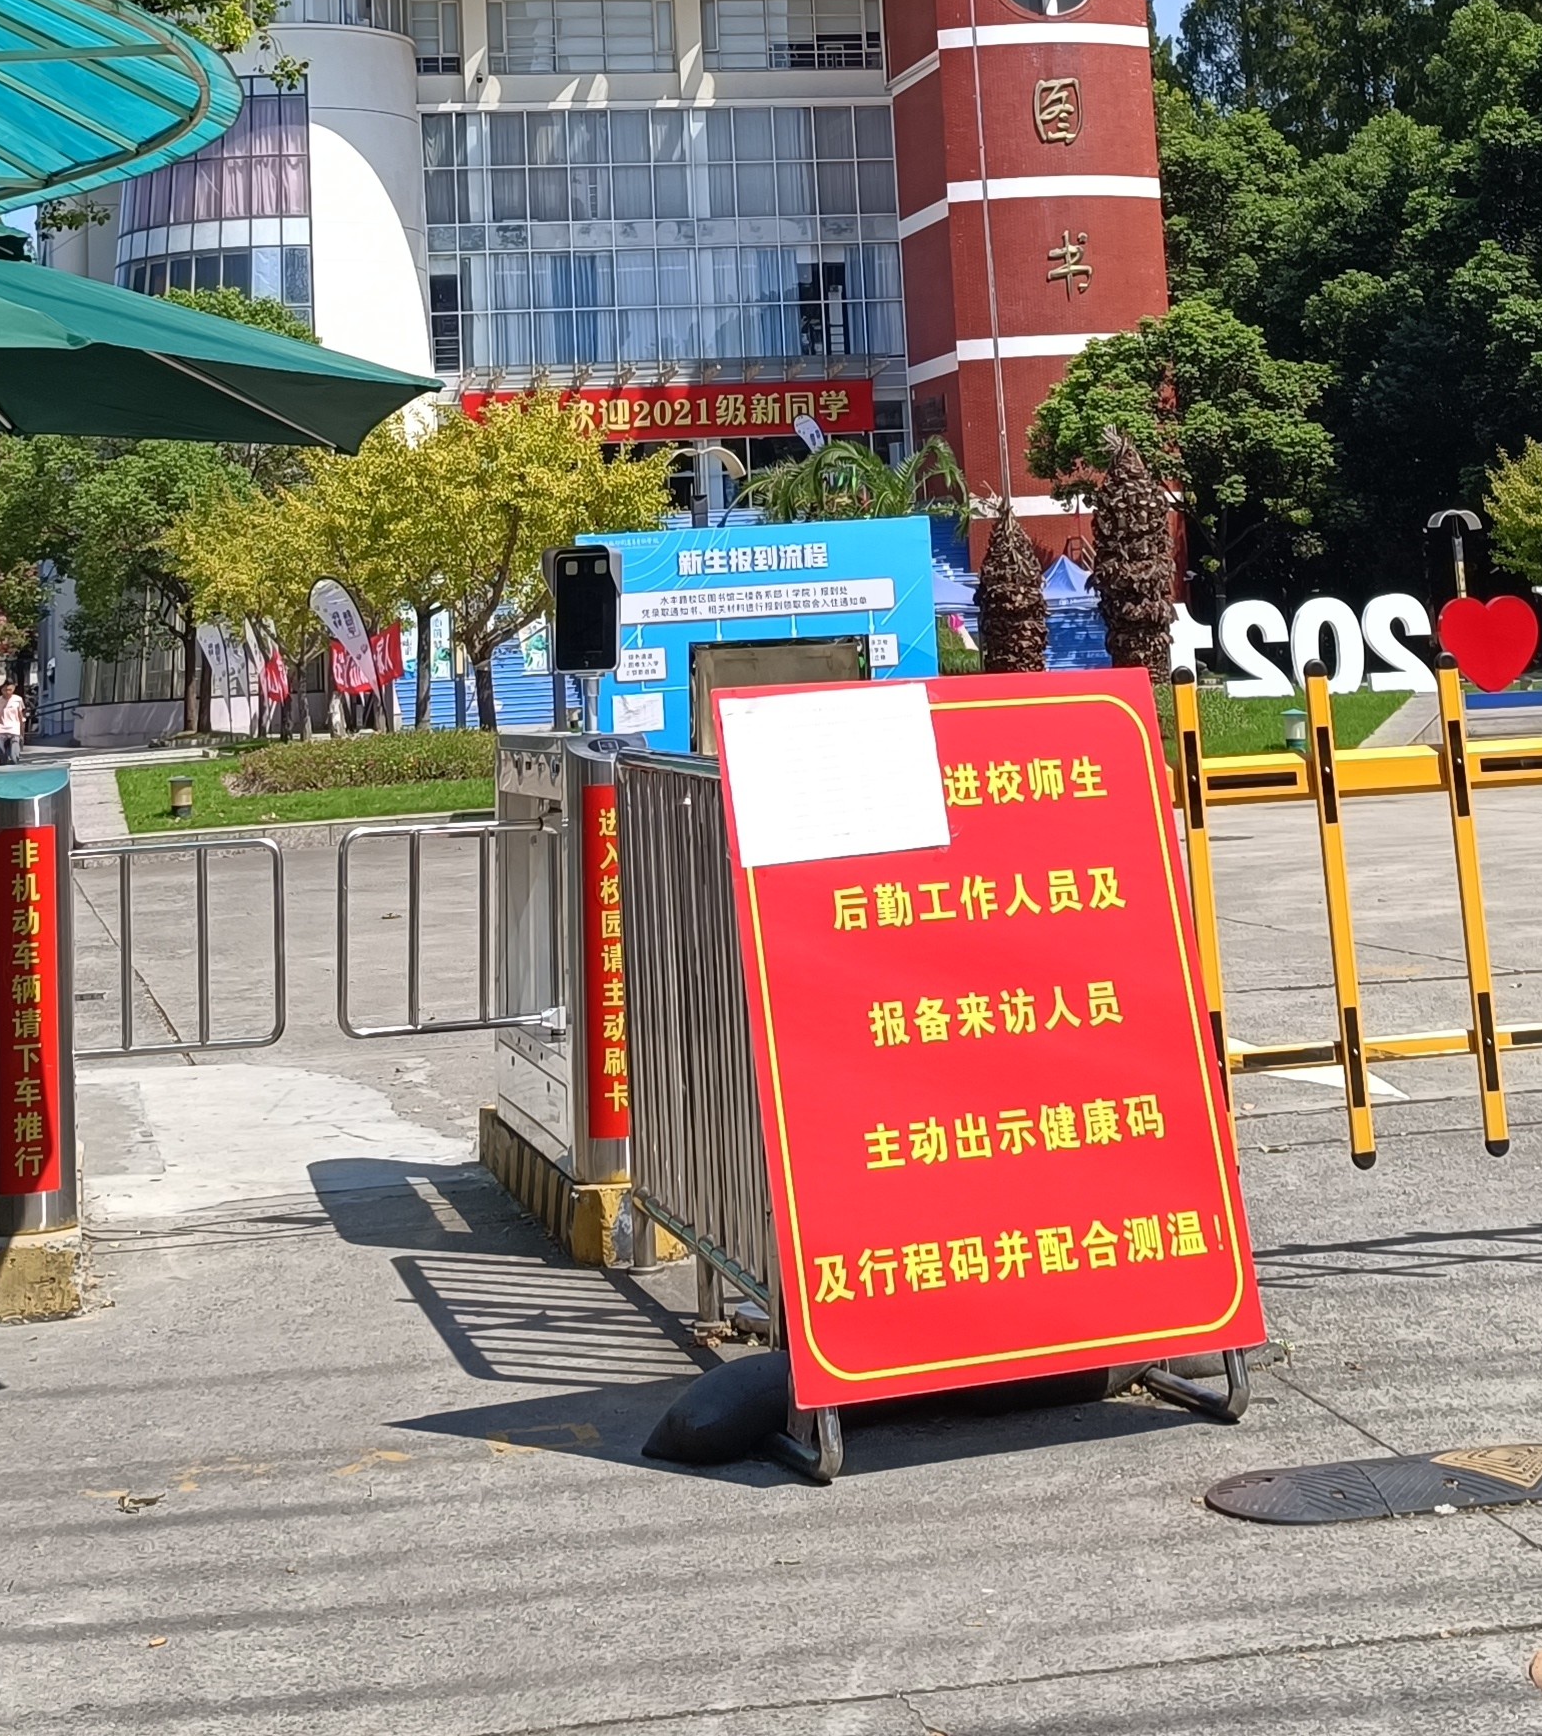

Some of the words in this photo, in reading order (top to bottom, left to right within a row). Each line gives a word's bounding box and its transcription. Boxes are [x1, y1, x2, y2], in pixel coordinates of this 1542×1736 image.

[678, 542, 829, 576] 新生报到流程
[943, 756, 1108, 807] 进校师生
[833, 866, 1126, 931] 后勤工作人员及
[10, 838, 46, 1178] 非机动车辆请下车推行
[867, 980, 1124, 1047] 报备来访人员
[864, 1094, 1165, 1170] 主动出示健康码
